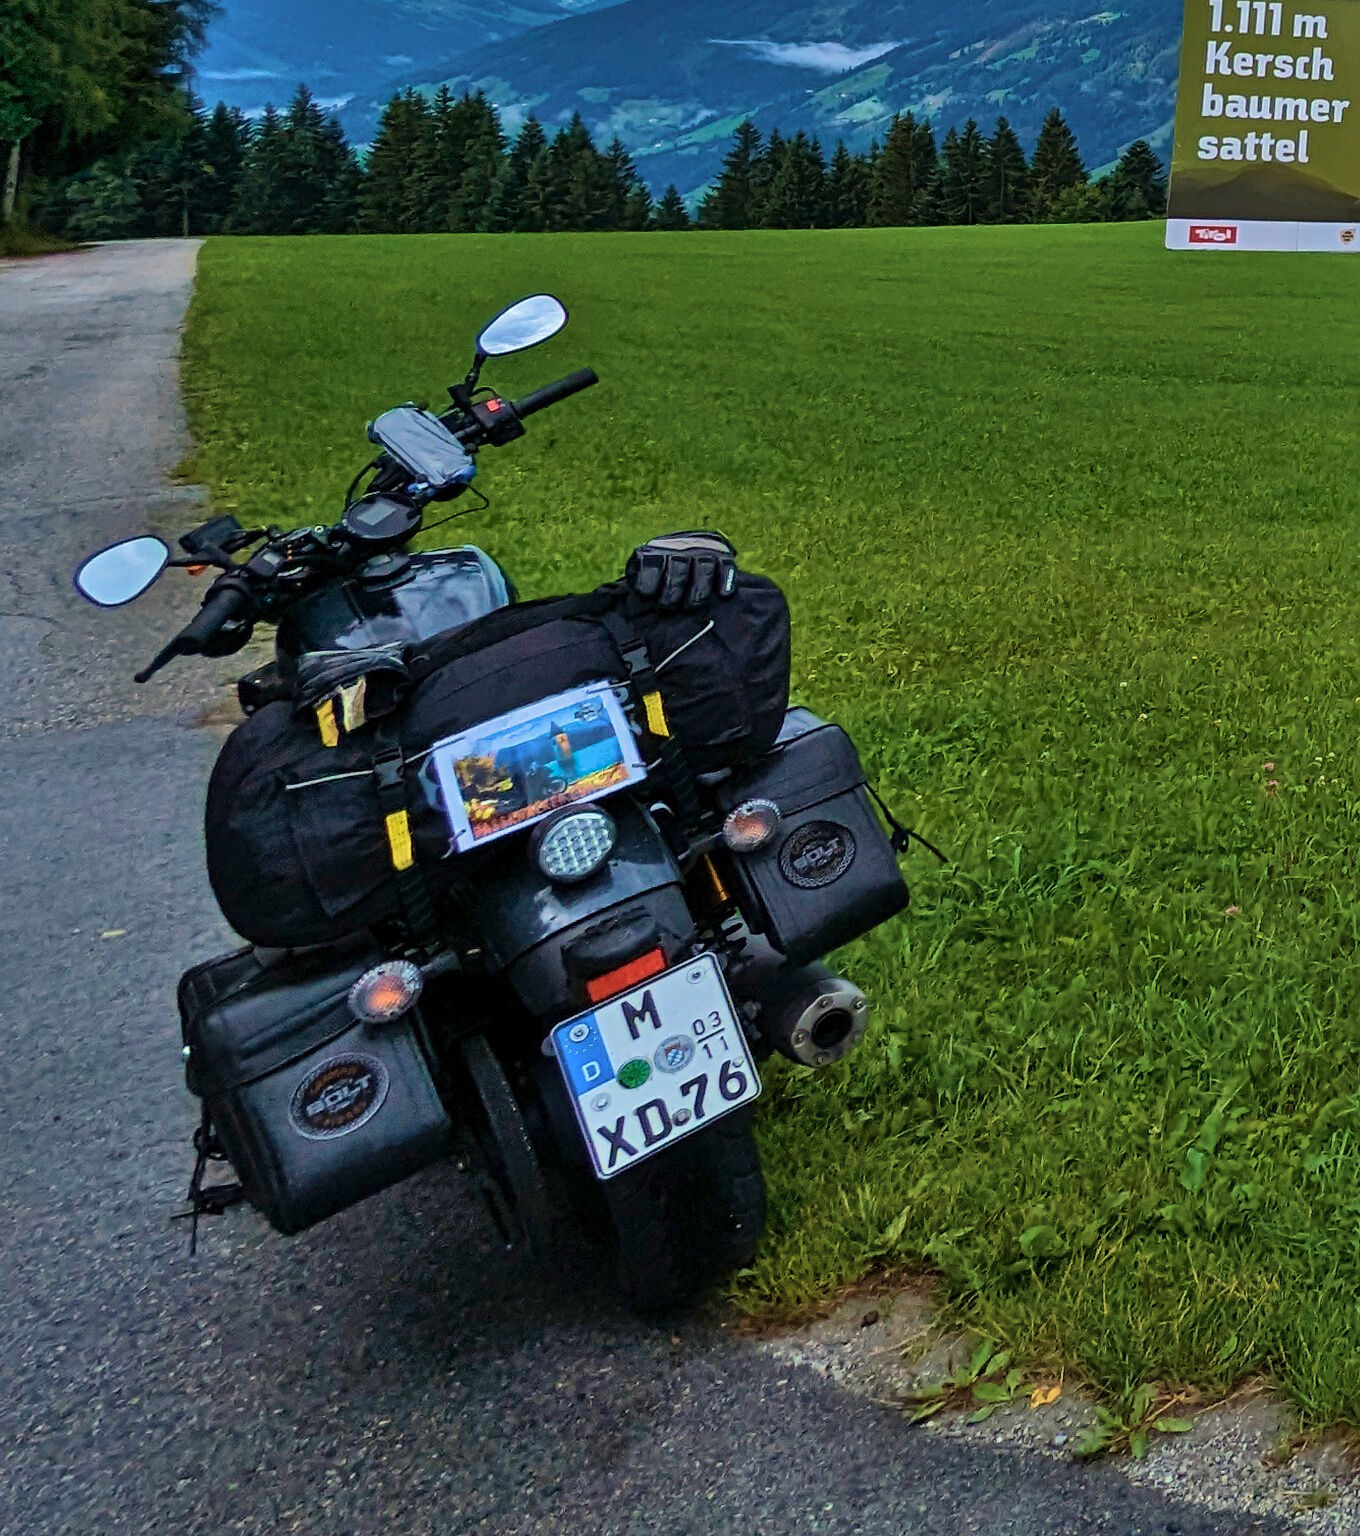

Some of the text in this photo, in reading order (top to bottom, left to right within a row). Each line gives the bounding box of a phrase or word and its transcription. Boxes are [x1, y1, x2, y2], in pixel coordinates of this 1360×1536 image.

[1293, 13, 1328, 39] m
[1205, 41, 1335, 81] Kersch
[1201, 83, 1350, 123] baumer
[1197, 129, 1310, 163] sattel
[621, 989, 662, 1040] M
[693, 1011, 722, 1036] 03
[582, 1060, 601, 1082] D
